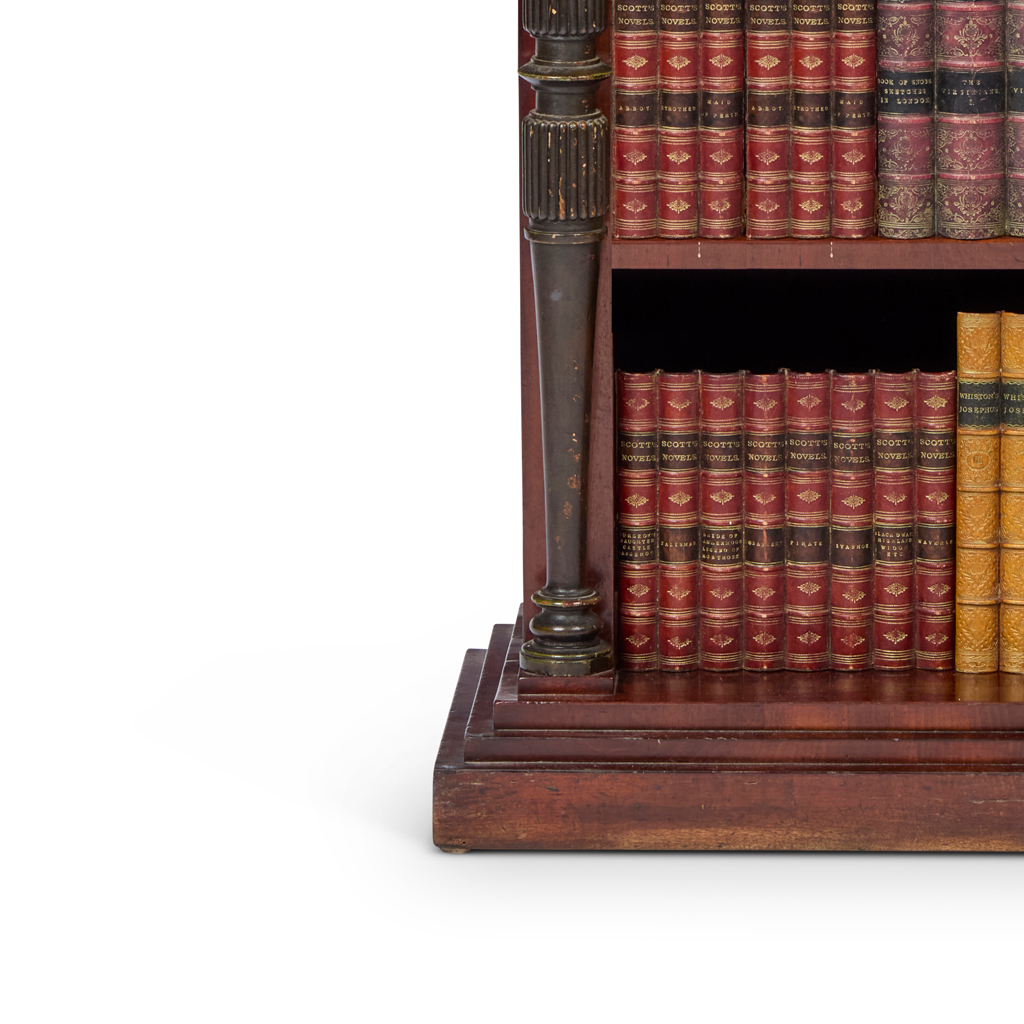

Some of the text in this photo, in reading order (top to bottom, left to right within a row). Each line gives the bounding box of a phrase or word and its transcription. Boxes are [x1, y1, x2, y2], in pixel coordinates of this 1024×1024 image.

[617, 4, 655, 12] SCOTT'S
[660, 4, 698, 12] SCOTT'S
[704, 3, 742, 11] SCOTT'S
[749, 4, 788, 12] SCOTT'S
[792, 4, 831, 12] SCOTT'S
[837, 3, 875, 12] SCOTT'S
[896, 97, 930, 105] LONDON
[959, 391, 999, 400] WHISTON'S
[959, 405, 999, 414] JOSEPHUS
[620, 440, 658, 449] SCOTT'S
[661, 440, 698, 448] SCOTT'S
[702, 440, 740, 449] SCOTT'S
[747, 440, 785, 449] SCOTT'S
[789, 438, 828, 447] SCOTT'S
[833, 442, 871, 450] SCOTT'S
[876, 439, 913, 447] SCOTT'
